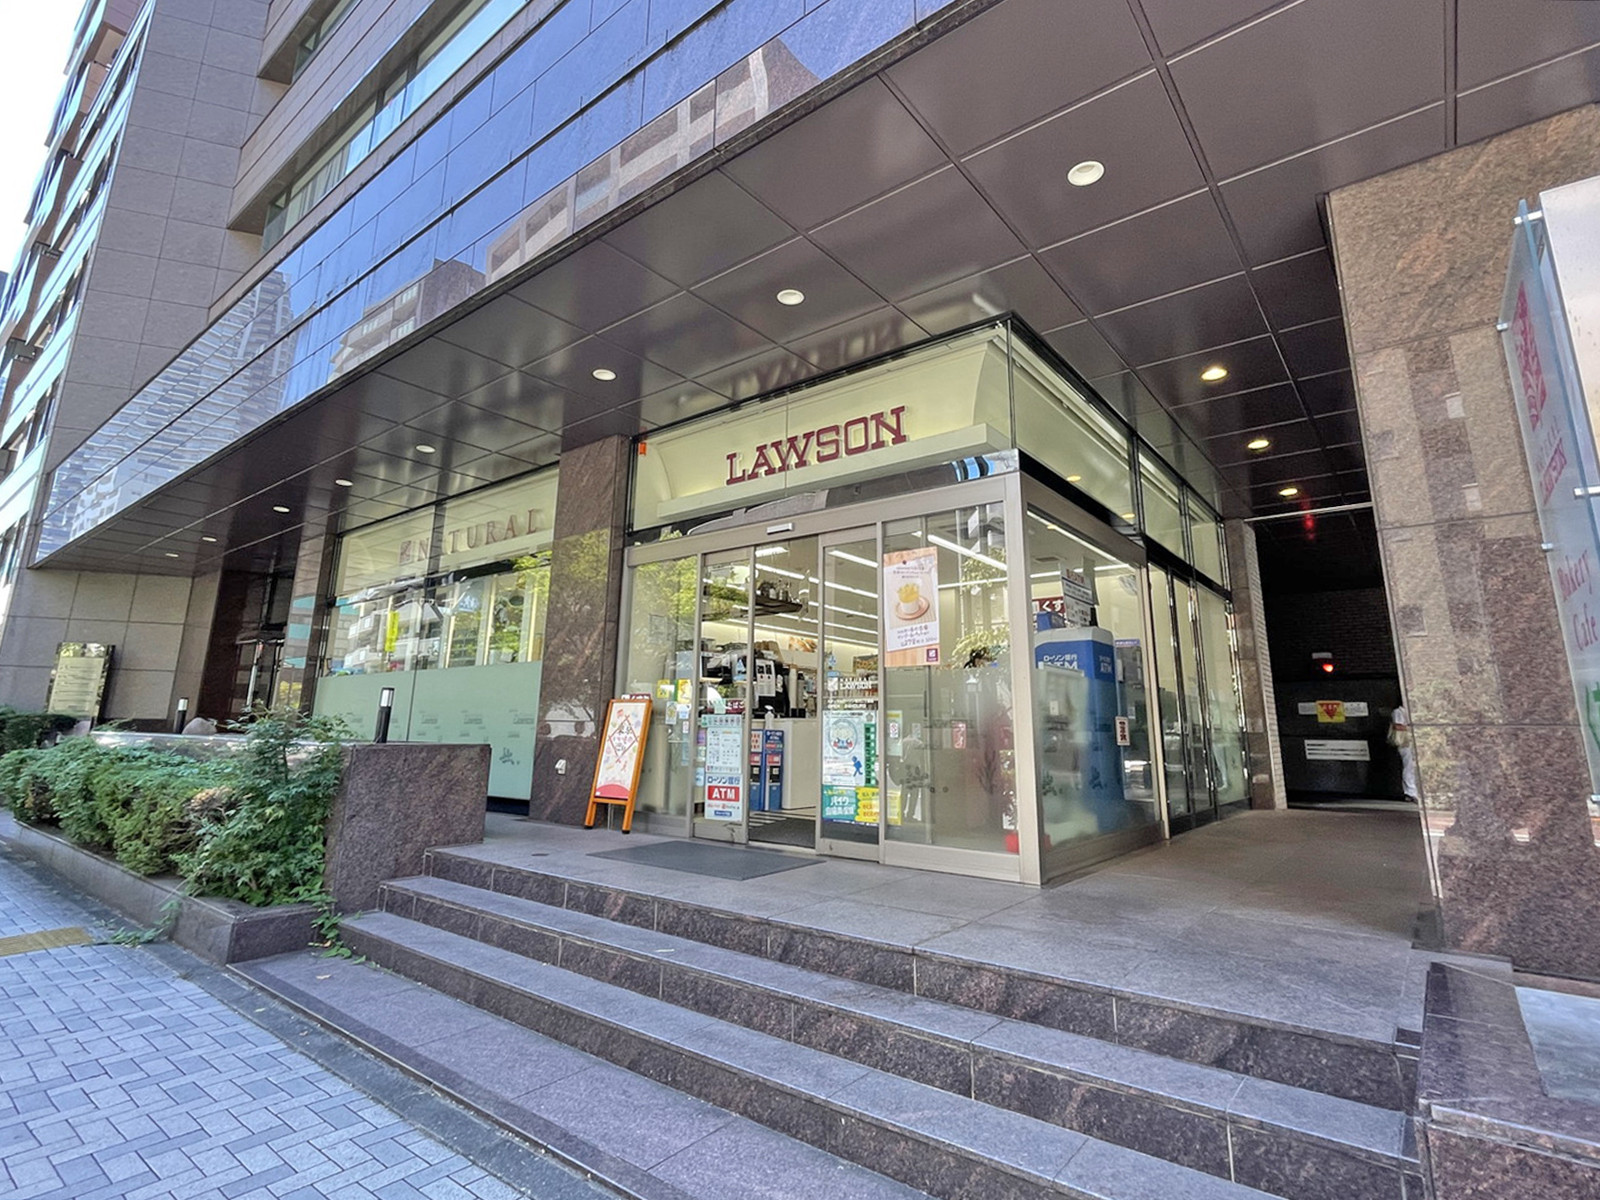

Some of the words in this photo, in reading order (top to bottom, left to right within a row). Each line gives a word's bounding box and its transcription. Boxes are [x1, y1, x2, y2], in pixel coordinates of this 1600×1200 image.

[726, 405, 907, 486] LAWSON
[416, 508, 539, 562] NTURAL
[1557, 549, 1593, 602] Bakery
[1042, 598, 1065, 612] くす
[1573, 603, 1598, 652] Cafe
[1043, 653, 1078, 662] ローソン銀行
[706, 776, 741, 785] ローソン銀行
[712, 787, 736, 800] ATM
[830, 796, 849, 806] バイク
